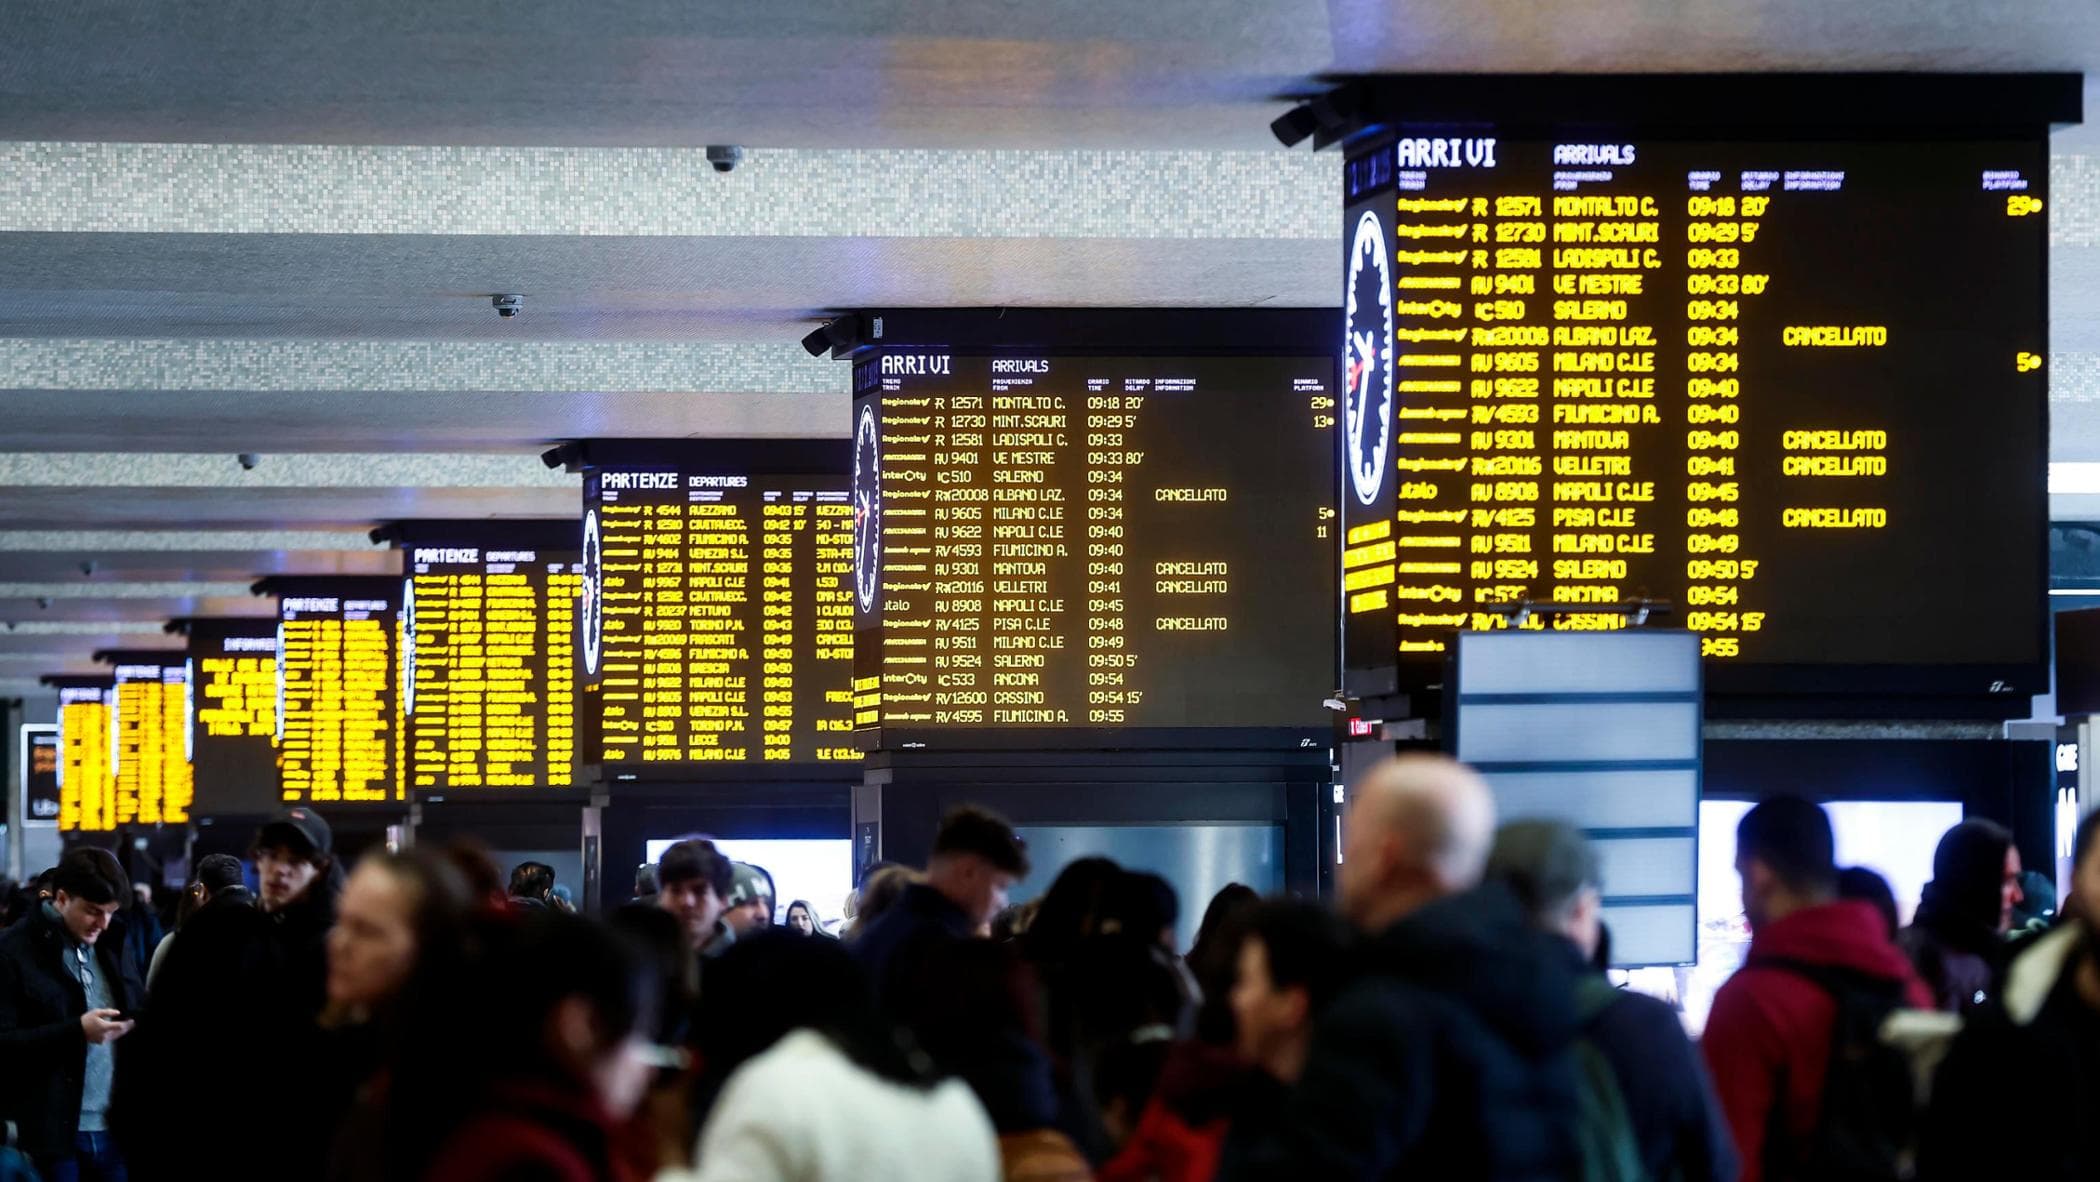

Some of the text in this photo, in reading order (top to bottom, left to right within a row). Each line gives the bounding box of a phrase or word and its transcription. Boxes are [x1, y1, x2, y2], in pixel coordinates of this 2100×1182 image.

[1398, 139, 1635, 167] ARRIVI ARRIVALS
[1554, 196, 2030, 216] MONTALTO 29
[1553, 248, 1640, 268] LADISPOLI
[1495, 274, 1535, 294] 9401
[1553, 274, 1576, 294] VE
[1579, 274, 1643, 294] MESTRE
[1688, 275, 1739, 294] 09:33
[1554, 300, 1739, 320] SALERNO 09:34
[1553, 327, 1886, 346] ALBANO LAZ. CANCELLATO
[882, 356, 1048, 374] ARRIVI ARRIVALS
[1554, 352, 1654, 372] MILANO C.LE
[935, 398, 944, 409] R
[952, 397, 983, 409] 12571
[993, 397, 1051, 409] MONTALTO
[1055, 397, 1066, 409] C.
[1088, 397, 1120, 409] 09:18
[1311, 397, 1326, 409] 29
[935, 416, 945, 428] R
[952, 415, 985, 428] 12730
[993, 415, 1066, 428] MINT.SCAURI
[1088, 416, 1123, 428] 09:29
[1314, 415, 1326, 427] 13
[935, 434, 1123, 446] R 12581 LADISPOLI C. 09:33
[1553, 430, 1886, 450] MANTOVA CANCELLATO
[935, 453, 948, 465] AV
[952, 452, 978, 464] 9401
[993, 452, 1008, 464] VE
[1012, 452, 1055, 464] MESTRE
[1088, 452, 1123, 464] 09:33
[1553, 456, 1886, 475] VELLETRI CANCELLATO
[602, 473, 747, 488] PARTENZE DEPARTURES
[952, 471, 971, 482] 510
[993, 471, 1043, 482] SALERNO
[1088, 471, 1123, 483] 09:34
[993, 489, 1227, 501] ALBANO LAZ. 09:34 CANCELLATO
[689, 505, 736, 516] AVEZZANO
[935, 507, 1327, 520] AV 9605 MILANO C.LE 09:34 5
[1553, 508, 1886, 527] PISA C.LE CANCELLATO
[935, 526, 1327, 538] AV 9622 NAPOLI C.LE 09:40 11
[414, 549, 479, 563] PARTENZE
[993, 544, 1053, 556] FIUMICINO
[1057, 544, 1068, 556] A.
[1088, 544, 1123, 556] 09:40
[936, 563, 1227, 575] AV 9301 MANTOVA 09:40 CANCELLATO
[689, 577, 722, 588] NAPOLI
[993, 581, 1227, 593] VELLETRI 09:41 CANCELLATO
[689, 605, 731, 616] NETTUNO
[936, 601, 949, 612] AV
[952, 600, 981, 611] 8908
[993, 600, 1034, 611] NAPOLI
[1039, 600, 1063, 611] C.LE
[1088, 600, 1123, 612] 09:45
[993, 618, 1021, 630] PISA
[1025, 618, 1050, 630] C.LE
[1088, 618, 1123, 630] 09:48
[1156, 618, 1227, 630] CANCELLATO
[936, 636, 1123, 649] AV 9511 MILANO C.LE 09:49
[936, 656, 949, 668] AV
[952, 655, 981, 667] 9524
[993, 655, 1044, 667] SALERNO
[1088, 655, 1124, 667] 09:50
[952, 673, 974, 685] 533
[993, 673, 1038, 685] ANCONA
[1088, 673, 1124, 685] 09:54
[993, 692, 1044, 704] CASSINO
[1088, 692, 1124, 704] 09:54
[993, 710, 1054, 722] FIUMICINO
[1058, 710, 1069, 722] A.
[1088, 710, 1124, 722] 09:55
